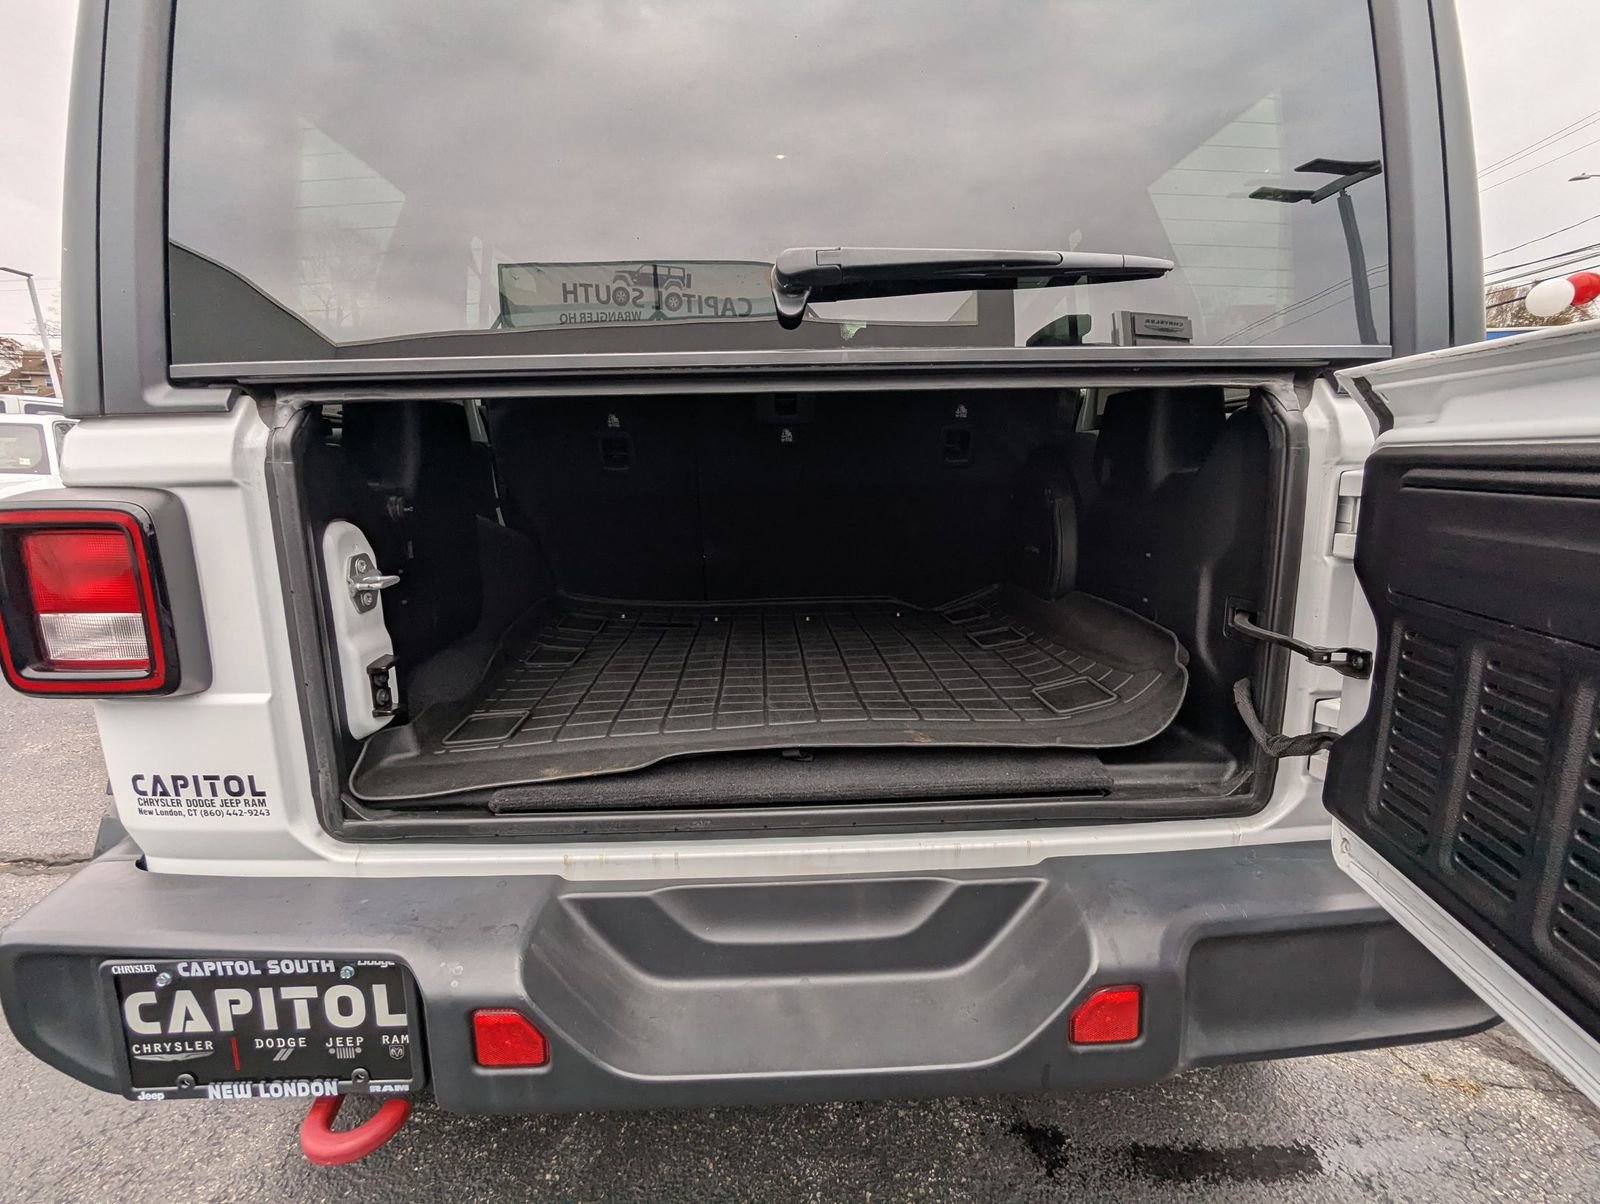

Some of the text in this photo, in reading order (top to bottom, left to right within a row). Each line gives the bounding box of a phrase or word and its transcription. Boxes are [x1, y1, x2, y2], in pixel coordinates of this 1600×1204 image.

[131, 774, 267, 797] CAPITOL
[137, 797, 267, 808] CHRYSLER DODGE JEEP RAM
[137, 808, 271, 818] New London, CT (860) 442-9243
[111, 964, 158, 975] CHRYSLER
[177, 959, 336, 977] CAPITOL SOUTH
[124, 984, 408, 1034] CAPITOL
[132, 1034, 410, 1055] CHRYSLER DODGE JEEP RAM
[208, 1080, 339, 1099] NEW LONDON
[369, 1084, 410, 1092] RAM
[137, 1091, 165, 1101] Jeep
